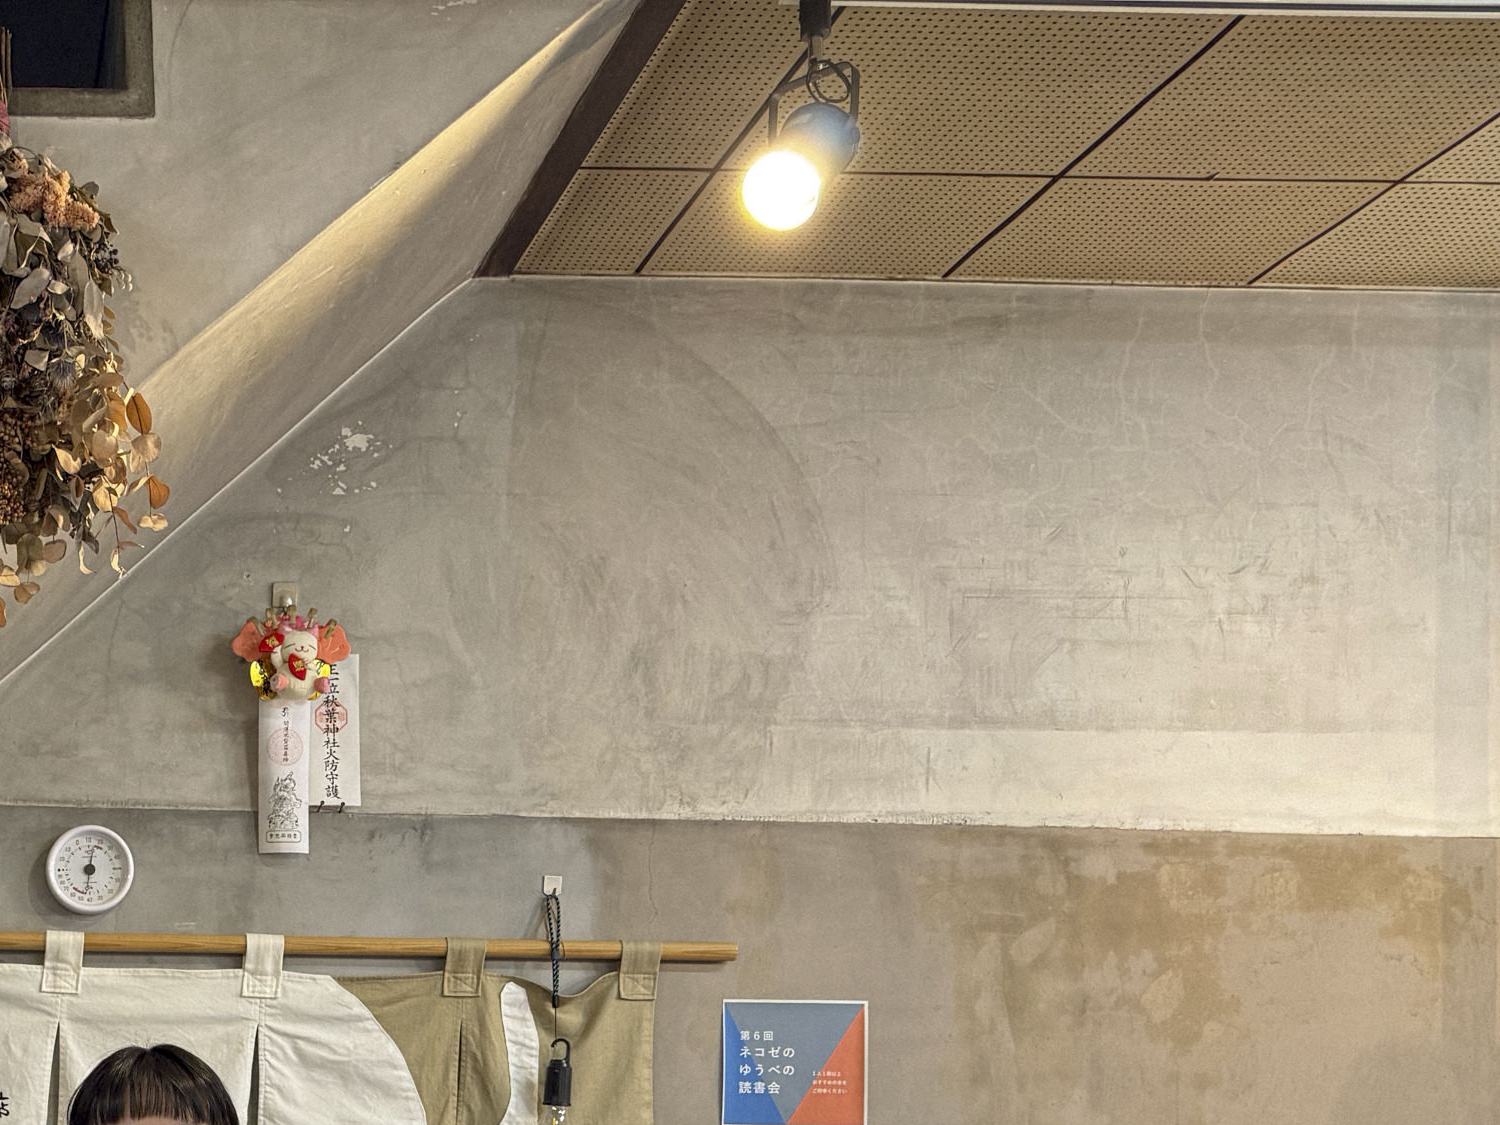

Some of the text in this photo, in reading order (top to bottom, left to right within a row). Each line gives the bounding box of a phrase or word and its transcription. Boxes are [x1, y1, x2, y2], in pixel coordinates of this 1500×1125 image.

[740, 1030, 774, 1041] 第6回
[739, 1046, 795, 1059] ネコゼの
[739, 1063, 795, 1076] ゆうべの
[738, 1081, 781, 1094] 読書会
